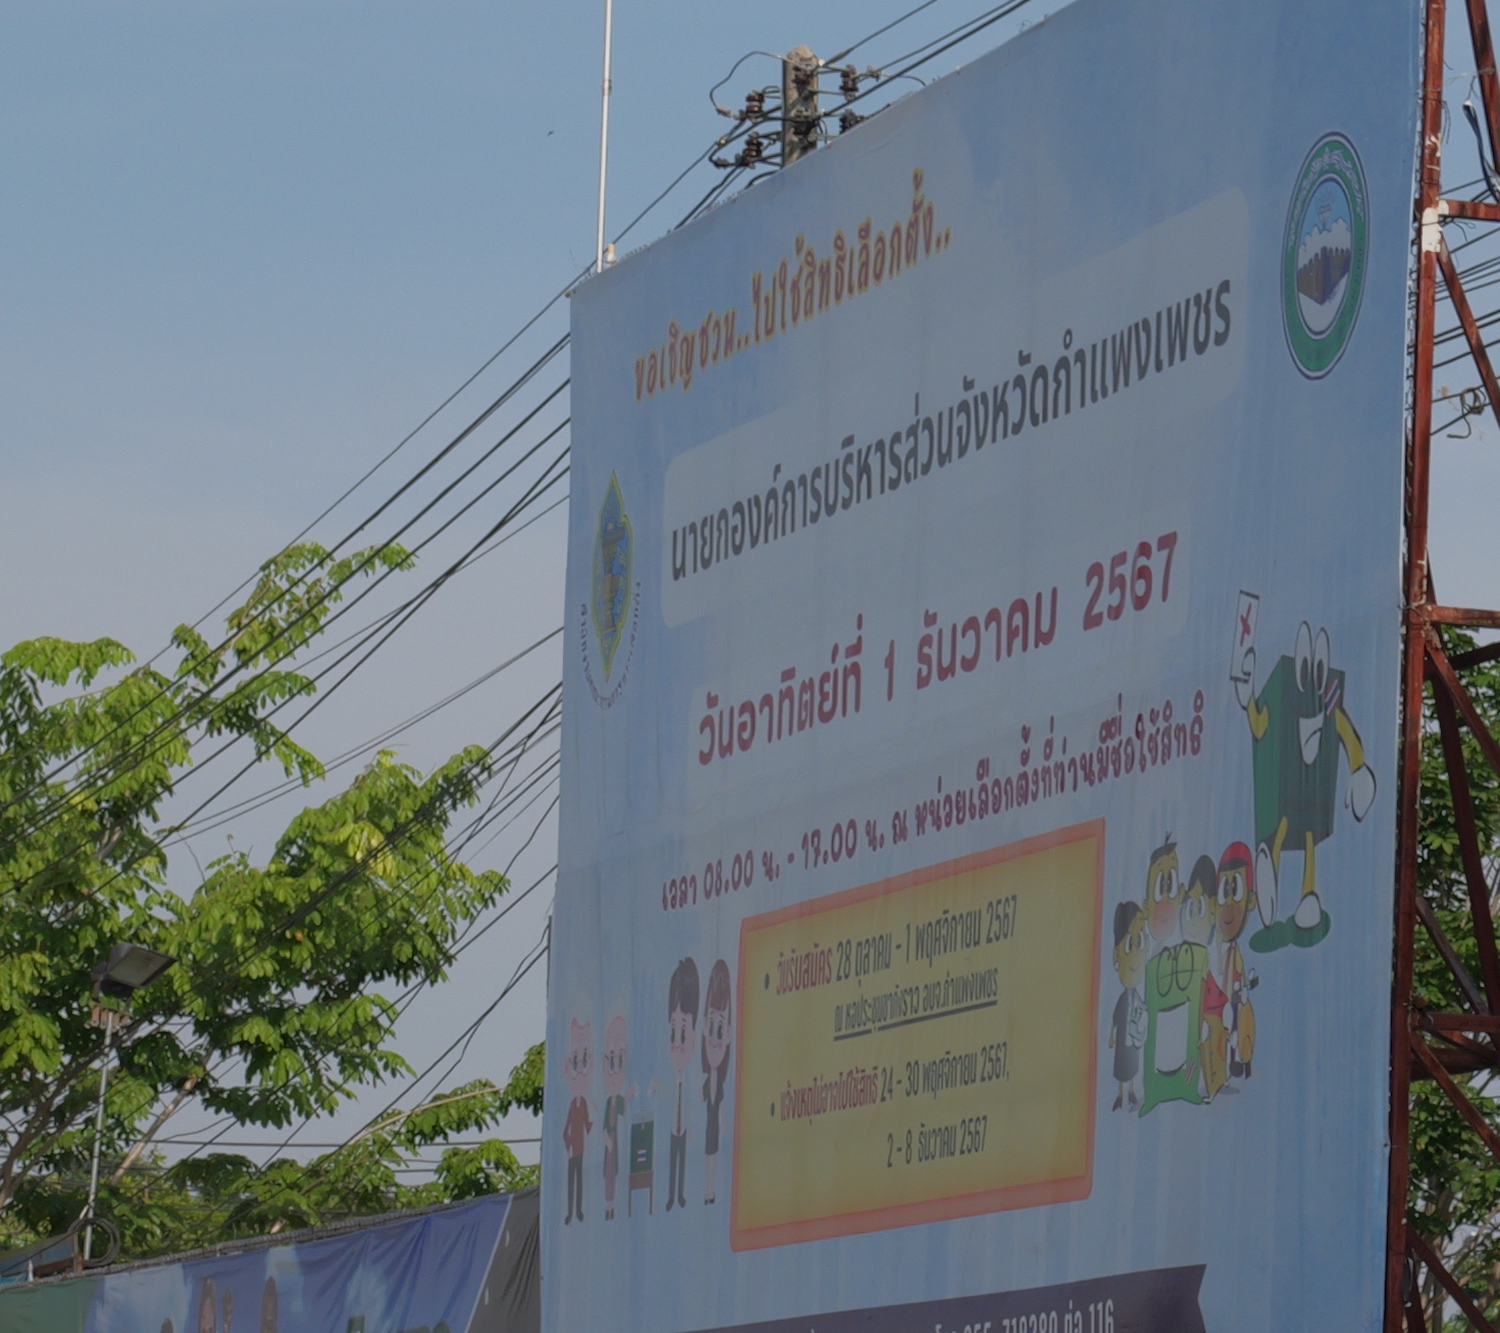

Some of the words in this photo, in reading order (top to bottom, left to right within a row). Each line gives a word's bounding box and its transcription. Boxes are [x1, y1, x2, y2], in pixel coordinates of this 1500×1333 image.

[670, 279, 1231, 582] นายกองค์การบริหารส่วนจังหวัดกำแพงเพชร
[699, 613, 863, 765] วันอาทิตย์ที่
[884, 640, 895, 701] 1
[916, 586, 1058, 690] ธันวาคม
[1082, 531, 1178, 631] 2567
[662, 873, 697, 911] เวลา
[703, 850, 755, 901] 08.00
[803, 819, 858, 871] 17.00
[892, 809, 908, 843] ณ
[776, 942, 833, 995] วันรับสมัคร
[836, 941, 852, 982] 28
[855, 932, 892, 986] ตุลาคม
[905, 922, 911, 963] 1
[915, 910, 982, 968] พฤศจิกายน
[986, 895, 1017, 944] 2567
[880, 1067, 893, 1103] 24
[905, 1061, 920, 1097] 30
[923, 1050, 977, 1099] พฤศจิกายน
[887, 1133, 894, 1168] 2
[905, 1129, 912, 1164] 8
[917, 1122, 957, 1162] ธันวาคม
[959, 1116, 987, 1156] 2567
